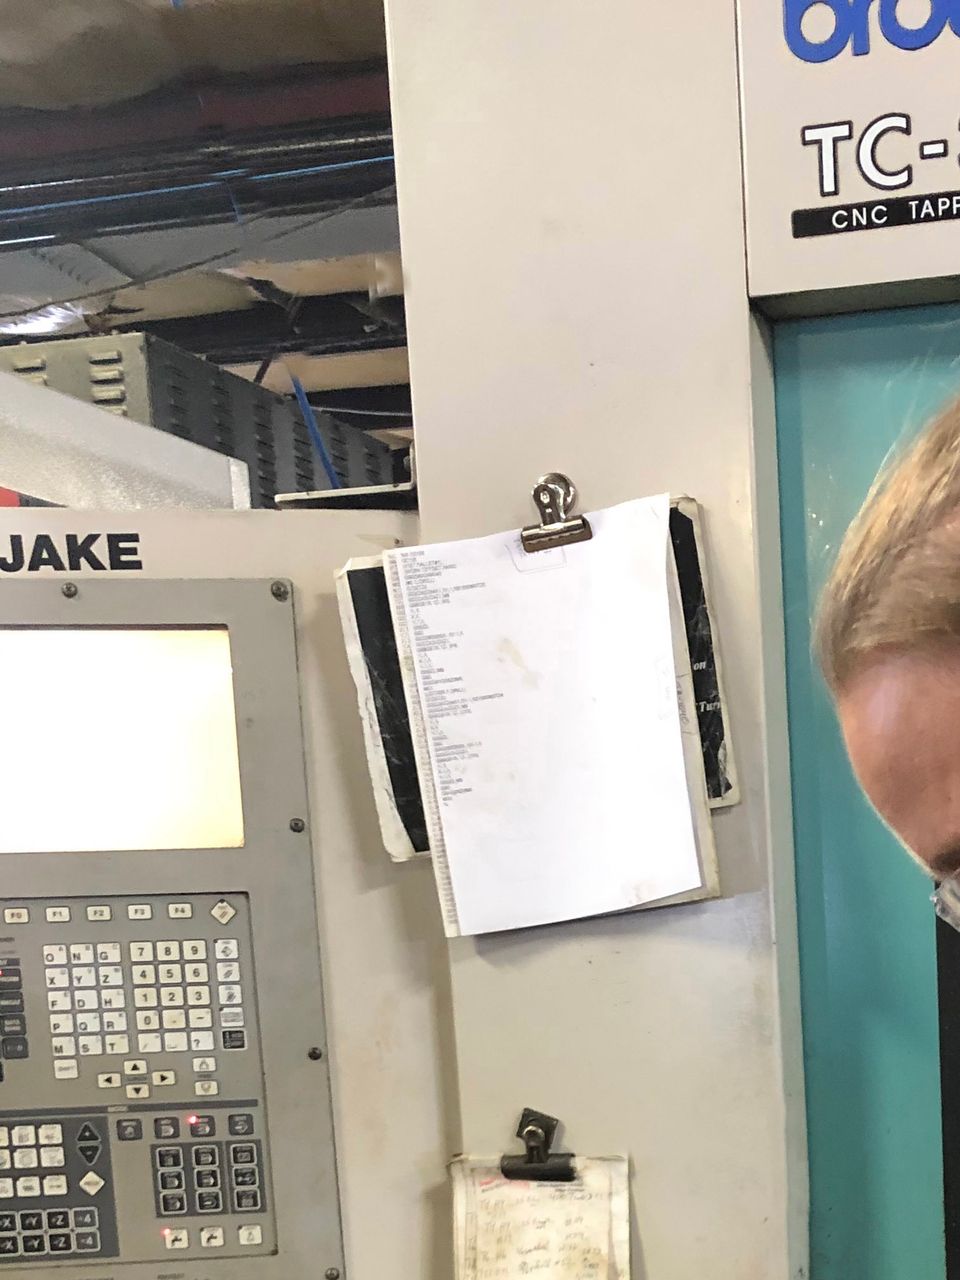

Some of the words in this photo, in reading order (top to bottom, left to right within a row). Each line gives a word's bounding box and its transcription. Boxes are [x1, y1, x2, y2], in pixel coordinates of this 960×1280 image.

[831, 205, 889, 230] CNC
[99, 951, 109, 961] G
[137, 947, 145, 957] 7
[164, 946, 172, 957] 8
[190, 945, 199, 955] 9
[48, 976, 56, 986] X
[74, 975, 83, 985] Y
[102, 974, 110, 984] Z
[139, 969, 147, 979] 4
[166, 968, 174, 978] 5
[192, 968, 201, 978] 6
[51, 1000, 59, 1009] F
[104, 998, 112, 1007] H
[142, 992, 148, 1002] 1
[168, 992, 176, 1002] 2
[194, 991, 203, 1001] 3
[52, 1023, 61, 1032] P
[78, 1021, 88, 1032] Q
[106, 1020, 114, 1030] R
[54, 1045, 64, 1054] M
[81, 1044, 90, 1053] S
[108, 1042, 116, 1052] T
